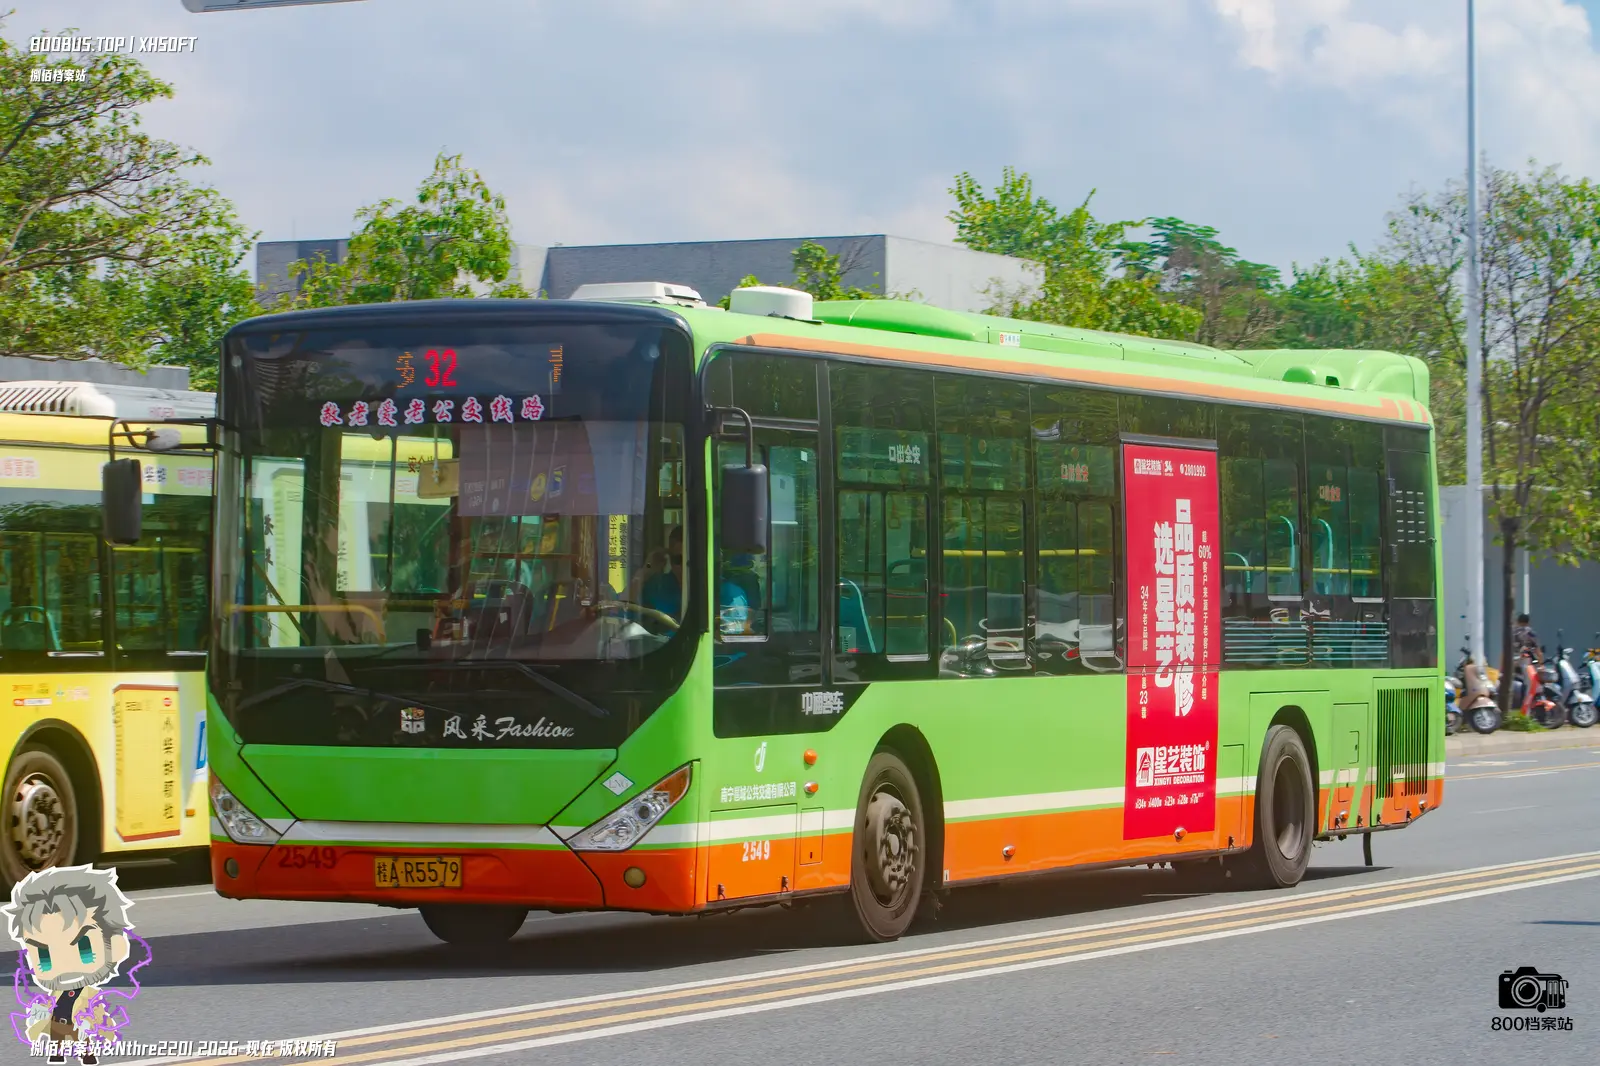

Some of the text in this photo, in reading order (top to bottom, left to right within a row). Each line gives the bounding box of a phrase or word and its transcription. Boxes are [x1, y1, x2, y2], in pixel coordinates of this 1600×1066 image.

[424, 348, 458, 388] 32
[319, 394, 546, 428] 敬老爱老公交线路
[1184, 464, 1207, 477] 2801992
[1154, 521, 1175, 688] 选星艺
[1174, 499, 1195, 717] 品质装修
[801, 690, 845, 715] 中通客车
[442, 713, 576, 743] 风采 Fashion
[1154, 744, 1205, 774] 星艺装饰
[277, 846, 337, 870] 2549
[742, 840, 771, 863] 2549
